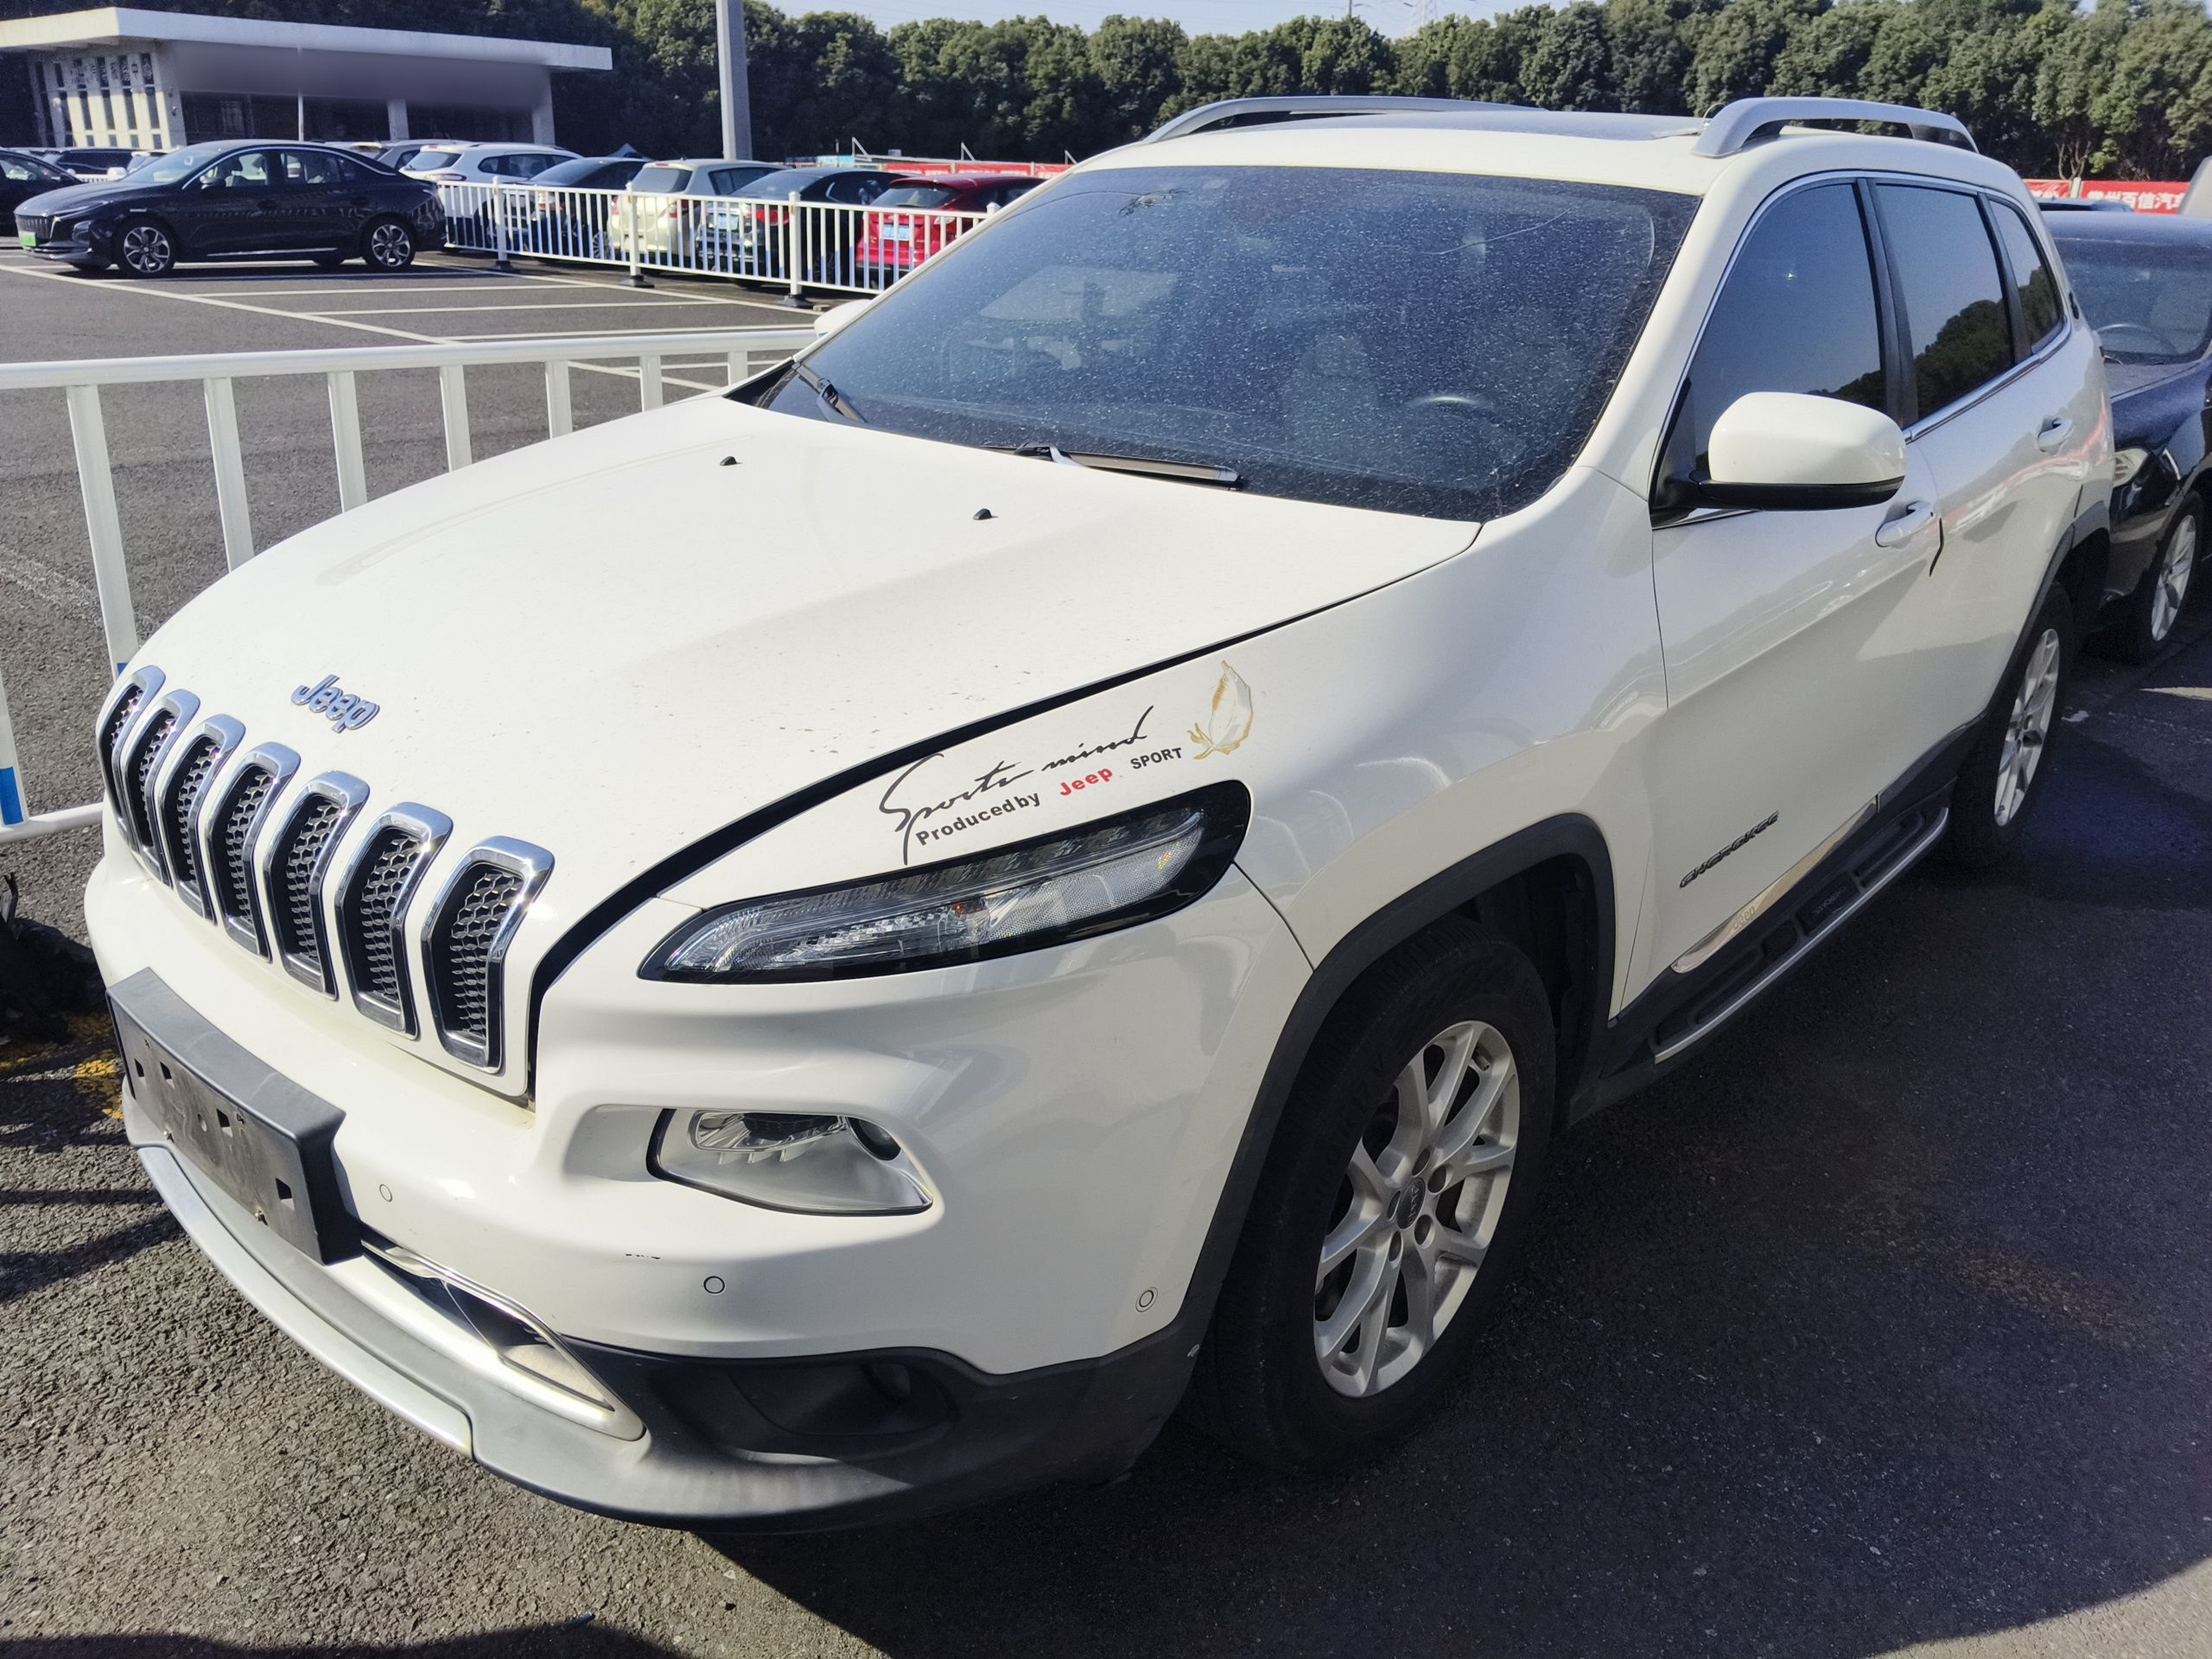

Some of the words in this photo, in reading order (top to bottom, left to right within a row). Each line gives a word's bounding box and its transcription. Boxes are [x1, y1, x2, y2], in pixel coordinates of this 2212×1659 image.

[291, 674, 380, 733] Jeep
[1041, 705, 1154, 771] mind
[1060, 768, 1113, 796] Jeep
[1130, 748, 1181, 769] SPORT
